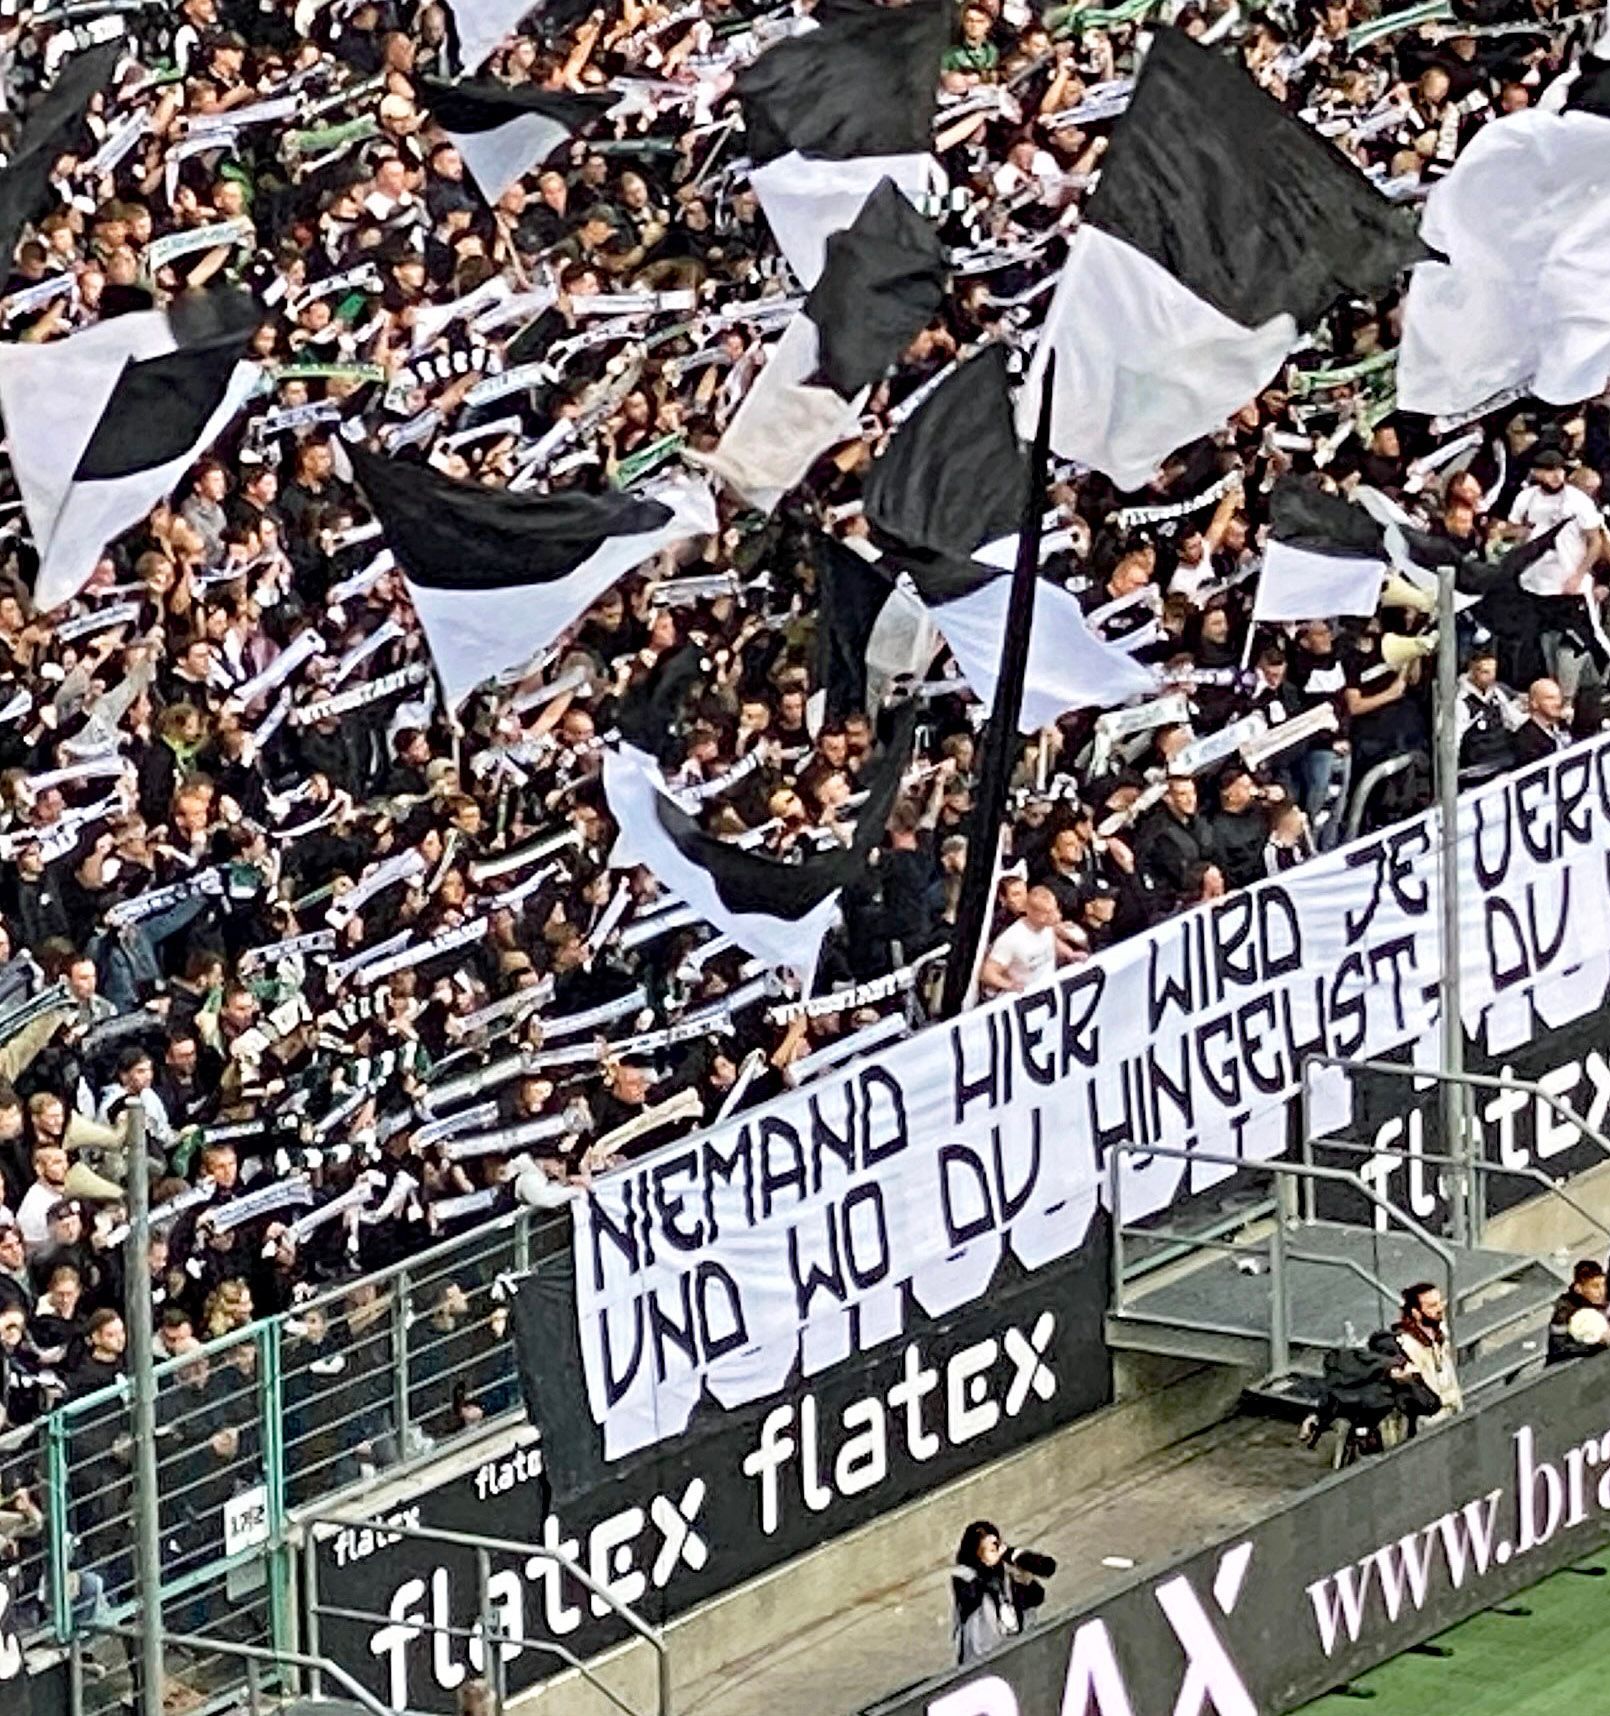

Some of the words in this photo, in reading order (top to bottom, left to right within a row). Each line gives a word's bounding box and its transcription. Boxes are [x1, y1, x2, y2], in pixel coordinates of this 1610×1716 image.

[591, 1064, 908, 1291] NIEMAND
[951, 966, 1106, 1124] HIER
[1148, 884, 1302, 1033] WIRD
[1345, 820, 1430, 945] JE
[598, 1261, 750, 1409] UND
[789, 1180, 889, 1317] WO
[939, 1106, 1042, 1249] DU
[1482, 866, 1569, 990] DU
[370, 1477, 707, 1712] flatex
[743, 1311, 1056, 1534] flatex
